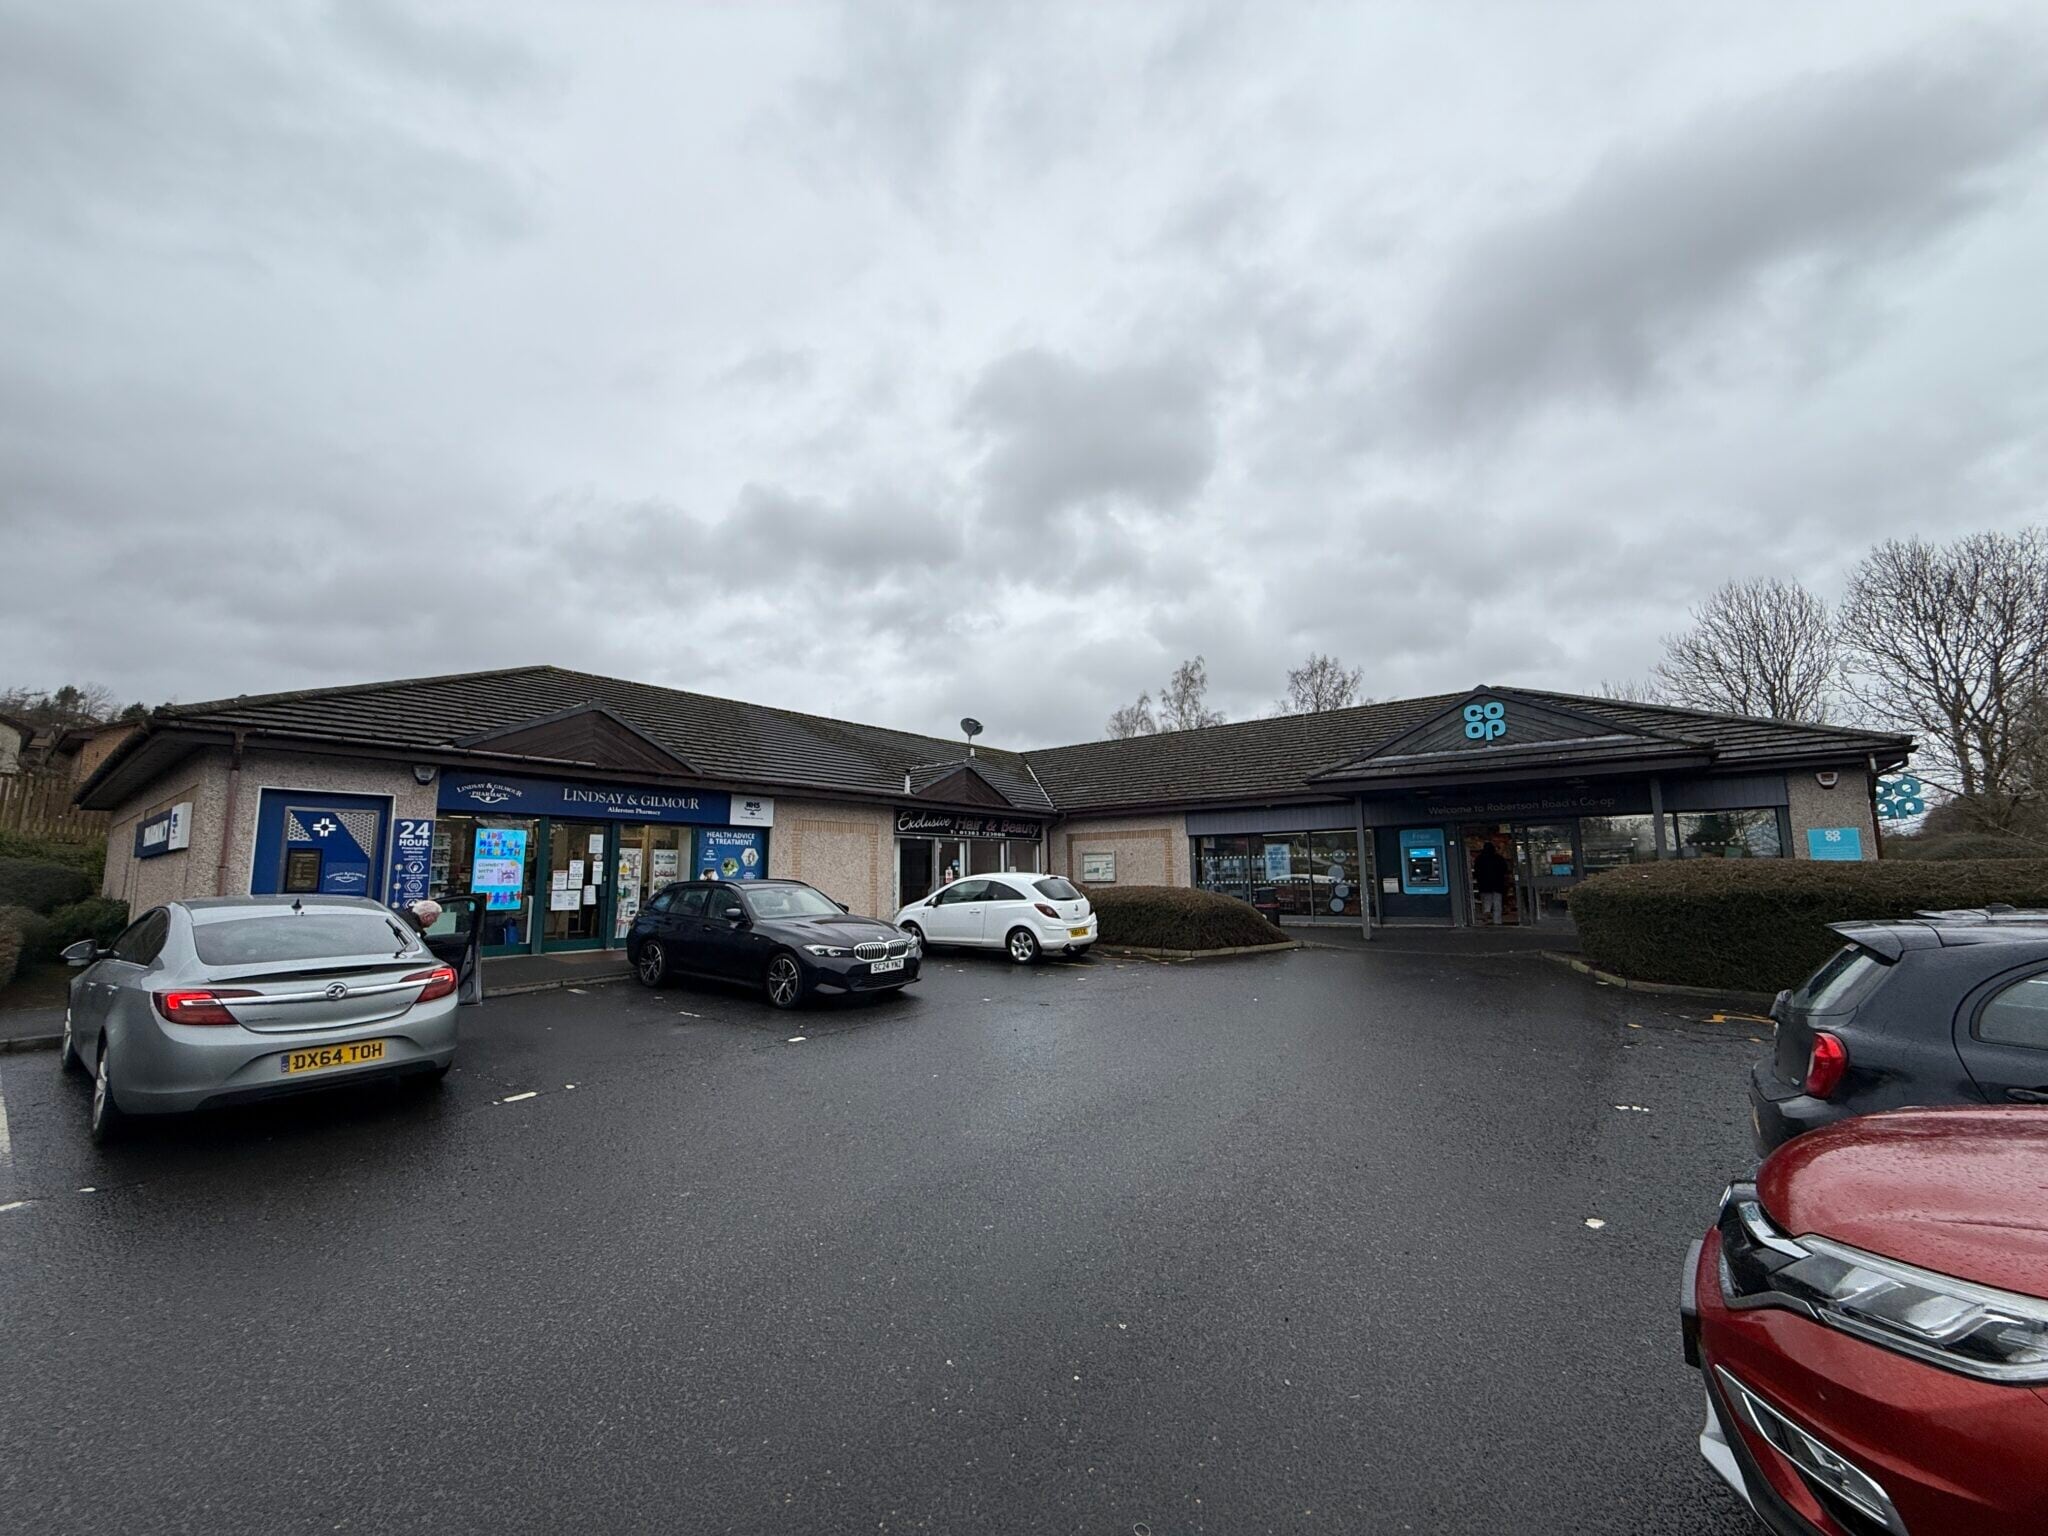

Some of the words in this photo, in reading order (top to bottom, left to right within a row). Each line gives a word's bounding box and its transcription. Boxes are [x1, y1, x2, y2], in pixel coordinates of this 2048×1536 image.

[456, 783, 485, 793] LINDSAY
[493, 785, 523, 797] GILMOUR
[563, 788, 625, 805] LINDSAY
[626, 794, 639, 806] &
[640, 795, 700, 810] GILMOUR
[745, 801, 761, 809] NHS
[1428, 805, 1472, 815] Welcome
[1475, 804, 1484, 813] to
[1487, 802, 1539, 812] Robertson
[636, 807, 661, 817] Pharmacy
[399, 821, 431, 839] 24
[897, 811, 952, 831] Exclusive
[985, 819, 998, 832] &
[1000, 820, 1040, 838] Beauty
[706, 831, 732, 839] HEALTH
[732, 832, 755, 840] ADVICE
[399, 838, 430, 847] HOUR
[716, 838, 753, 846] TREATMENT
[480, 848, 521, 856] HEALTH
[293, 1049, 344, 1070] DX64
[349, 1042, 383, 1061] TOH
